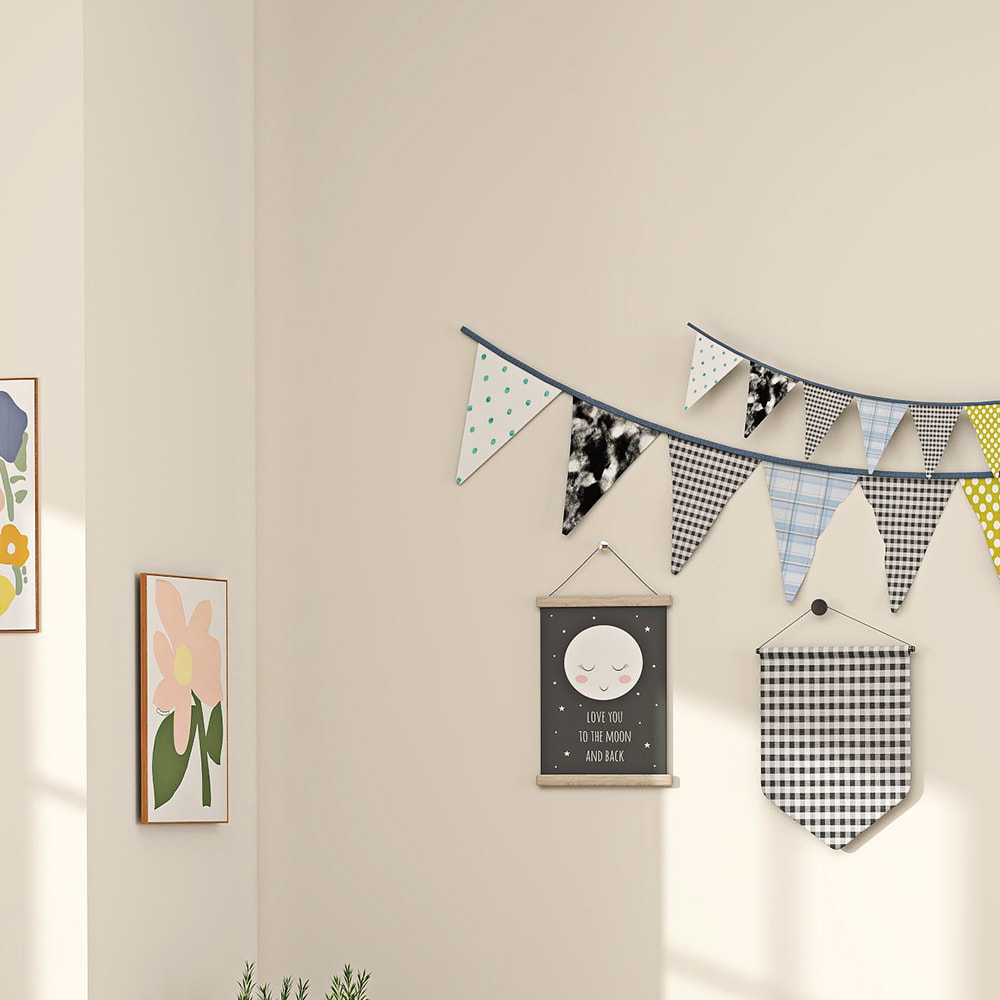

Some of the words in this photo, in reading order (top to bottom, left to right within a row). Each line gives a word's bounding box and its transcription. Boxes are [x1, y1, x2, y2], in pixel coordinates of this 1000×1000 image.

[587, 711, 605, 723] LOVE
[608, 711, 623, 723] YOU
[579, 730, 588, 742] TO
[591, 730, 603, 742] THE
[605, 730, 631, 743] MOON
[585, 750, 602, 762] AND
[605, 750, 624, 762] BACK
